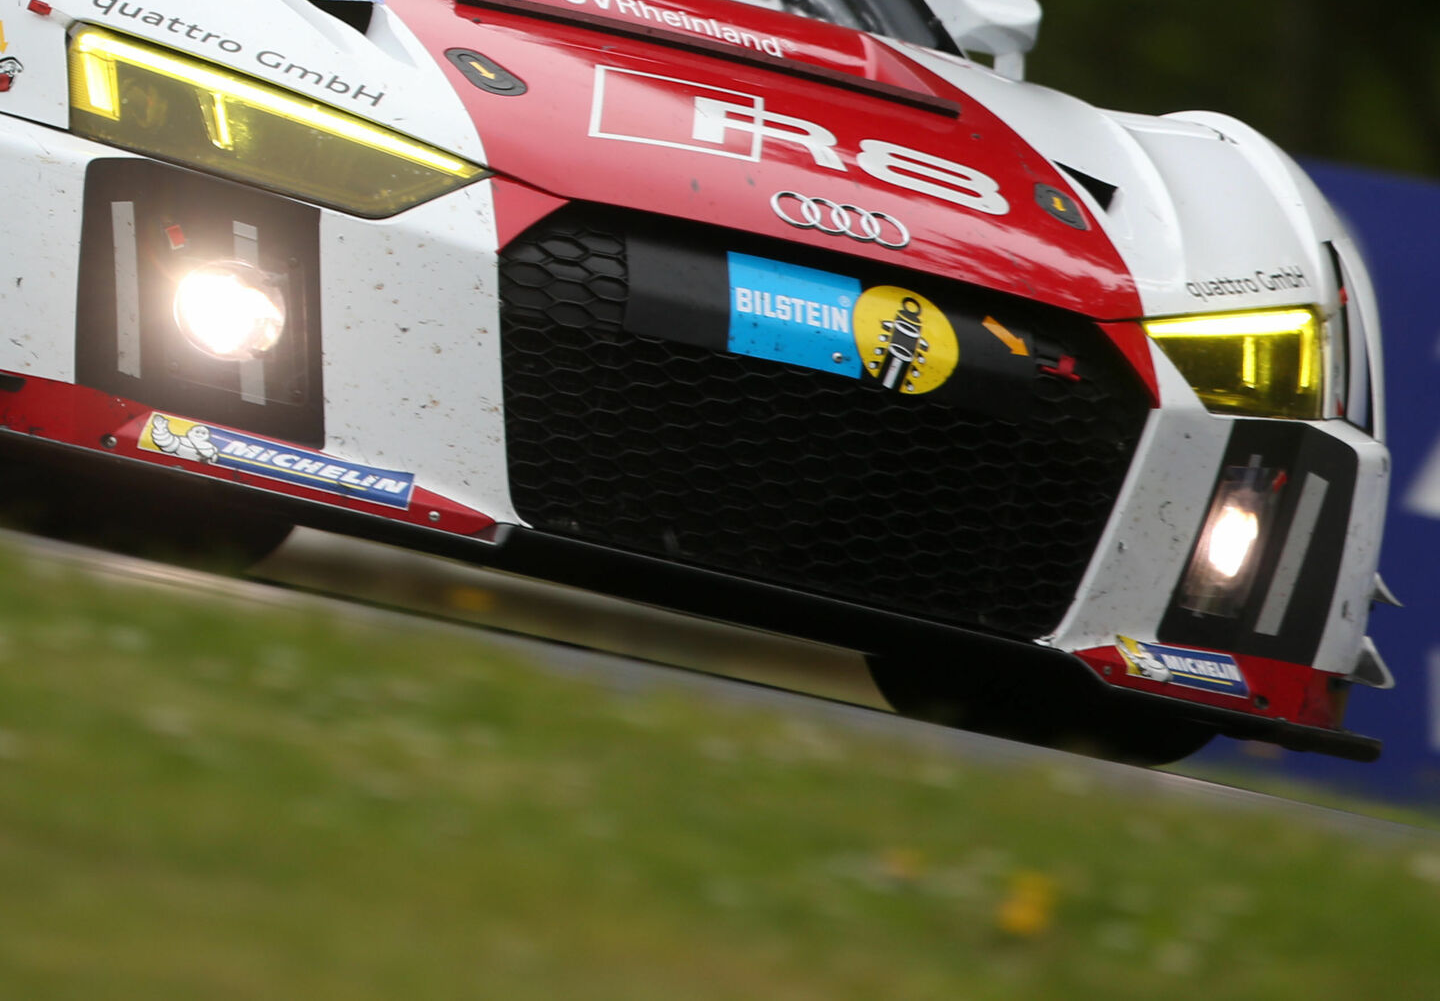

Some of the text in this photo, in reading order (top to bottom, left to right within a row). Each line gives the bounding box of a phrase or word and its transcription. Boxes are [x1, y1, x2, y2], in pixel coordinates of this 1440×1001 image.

[255, 49, 388, 108] GmbH
[691, 95, 1011, 216] R8
[1185, 265, 1310, 302] quattro GmbH
[734, 286, 850, 335] BILSTEIN
[223, 440, 410, 494] MICHELIN
[1160, 653, 1242, 682] MICHELIN
